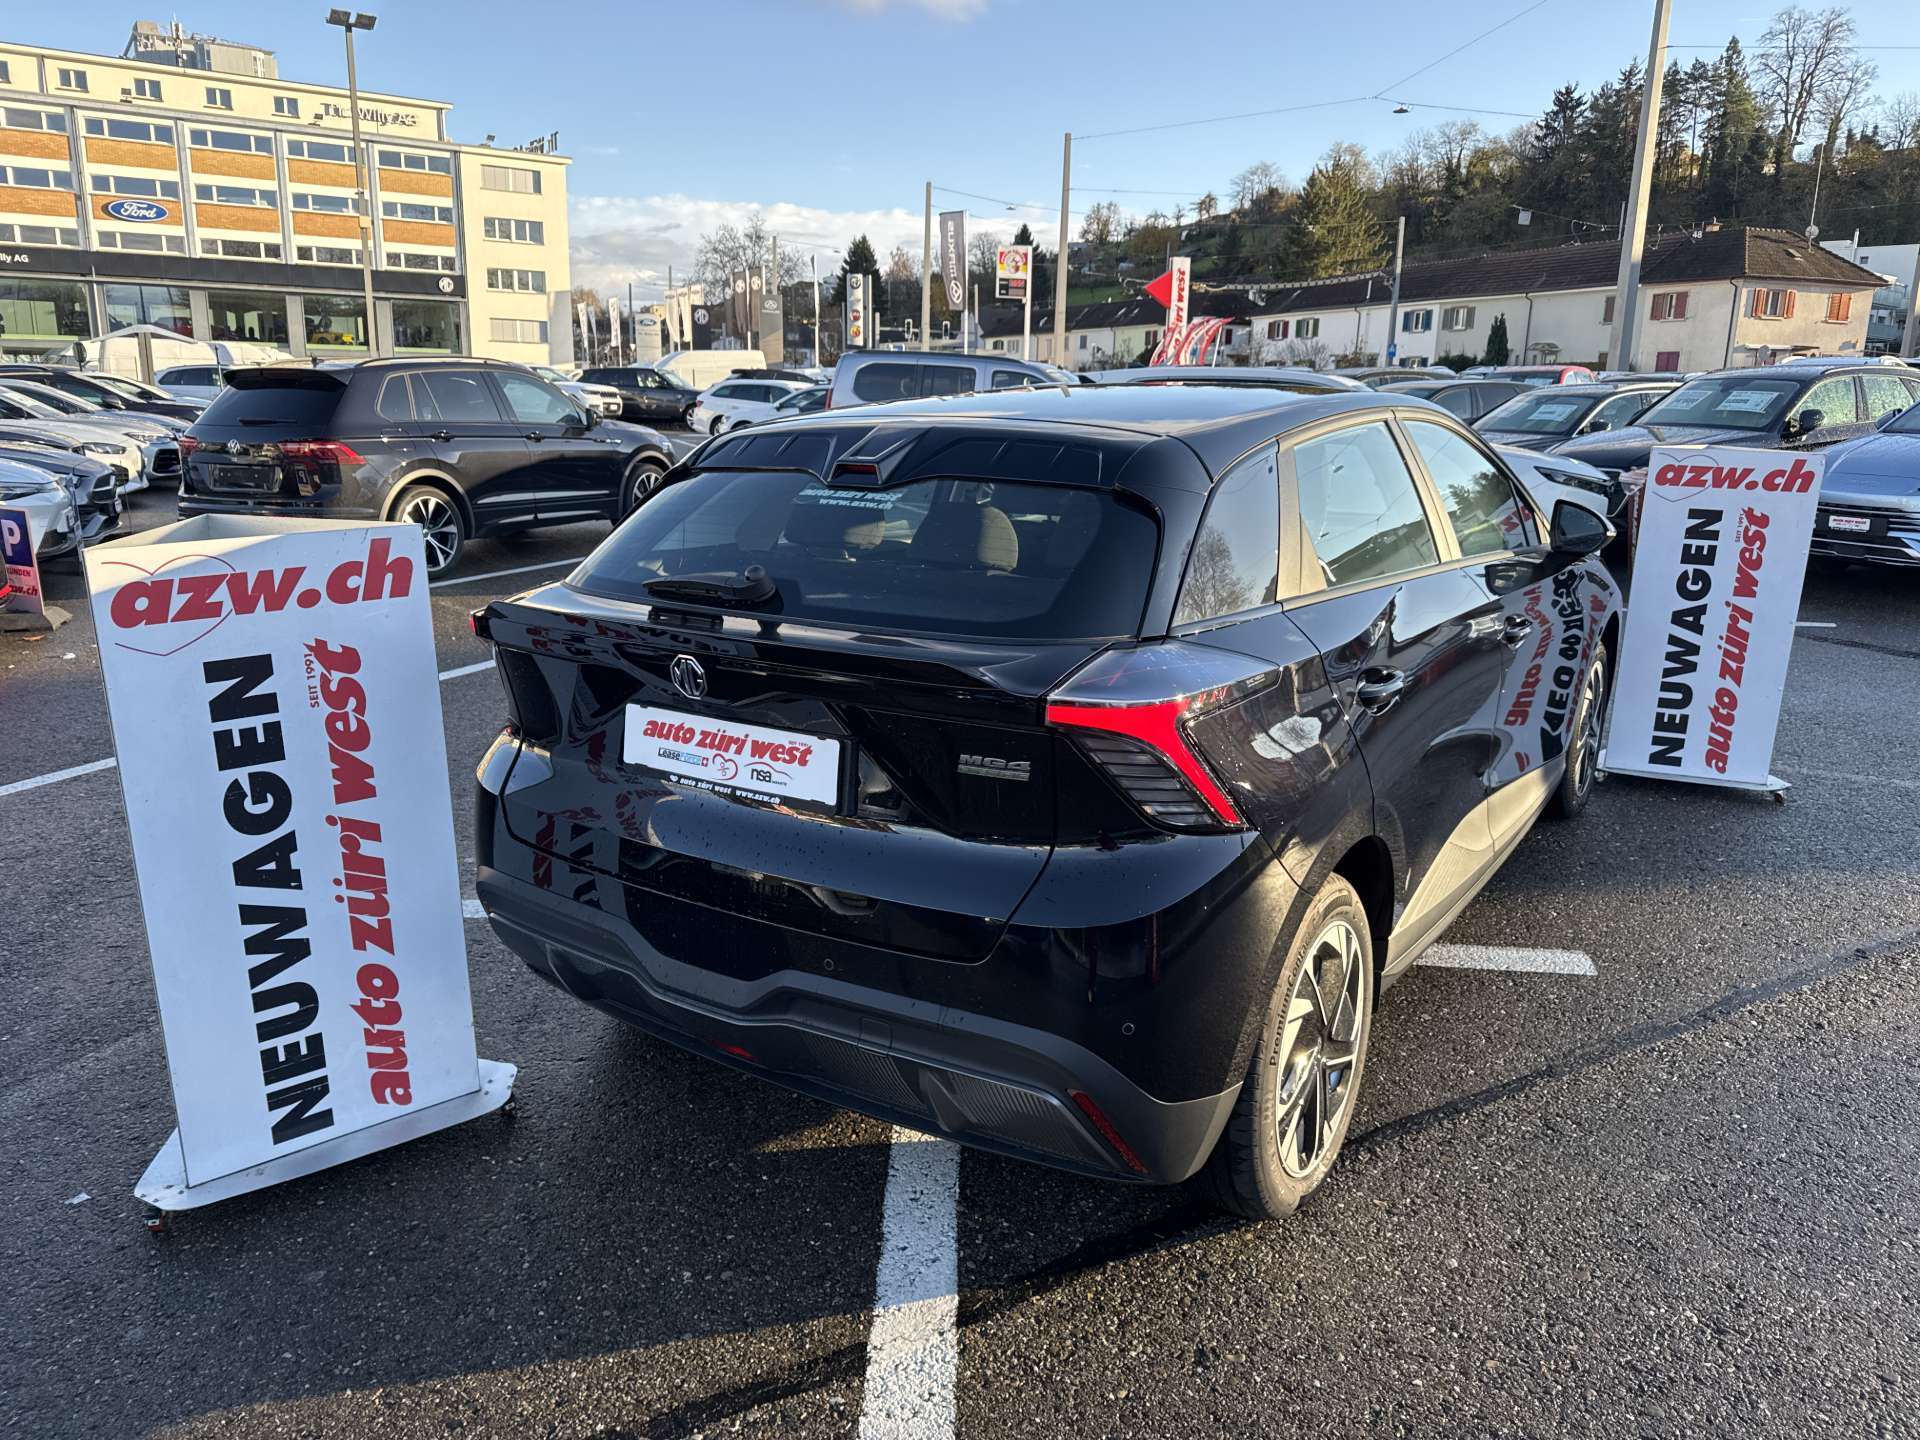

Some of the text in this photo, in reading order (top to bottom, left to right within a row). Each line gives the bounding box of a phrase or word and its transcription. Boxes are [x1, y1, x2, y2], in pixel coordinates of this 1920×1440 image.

[120, 201, 157, 219] Ford
[1692, 230, 1702, 239] 48
[14, 254, 30, 263] AG
[1655, 458, 1816, 493] azw.ch
[1, 519, 21, 556] P
[110, 537, 413, 628] azw.ch
[1648, 507, 1724, 768] NEUWAGEN
[1704, 505, 1771, 774] auto züri west
[304, 653, 320, 709] SEIT 1991
[643, 719, 813, 767] auto züri west
[959, 754, 1032, 771] MG4
[750, 768, 772, 783] nsa
[302, 637, 413, 1106] auto züri west
[203, 653, 334, 1145] NEUWAGEN
